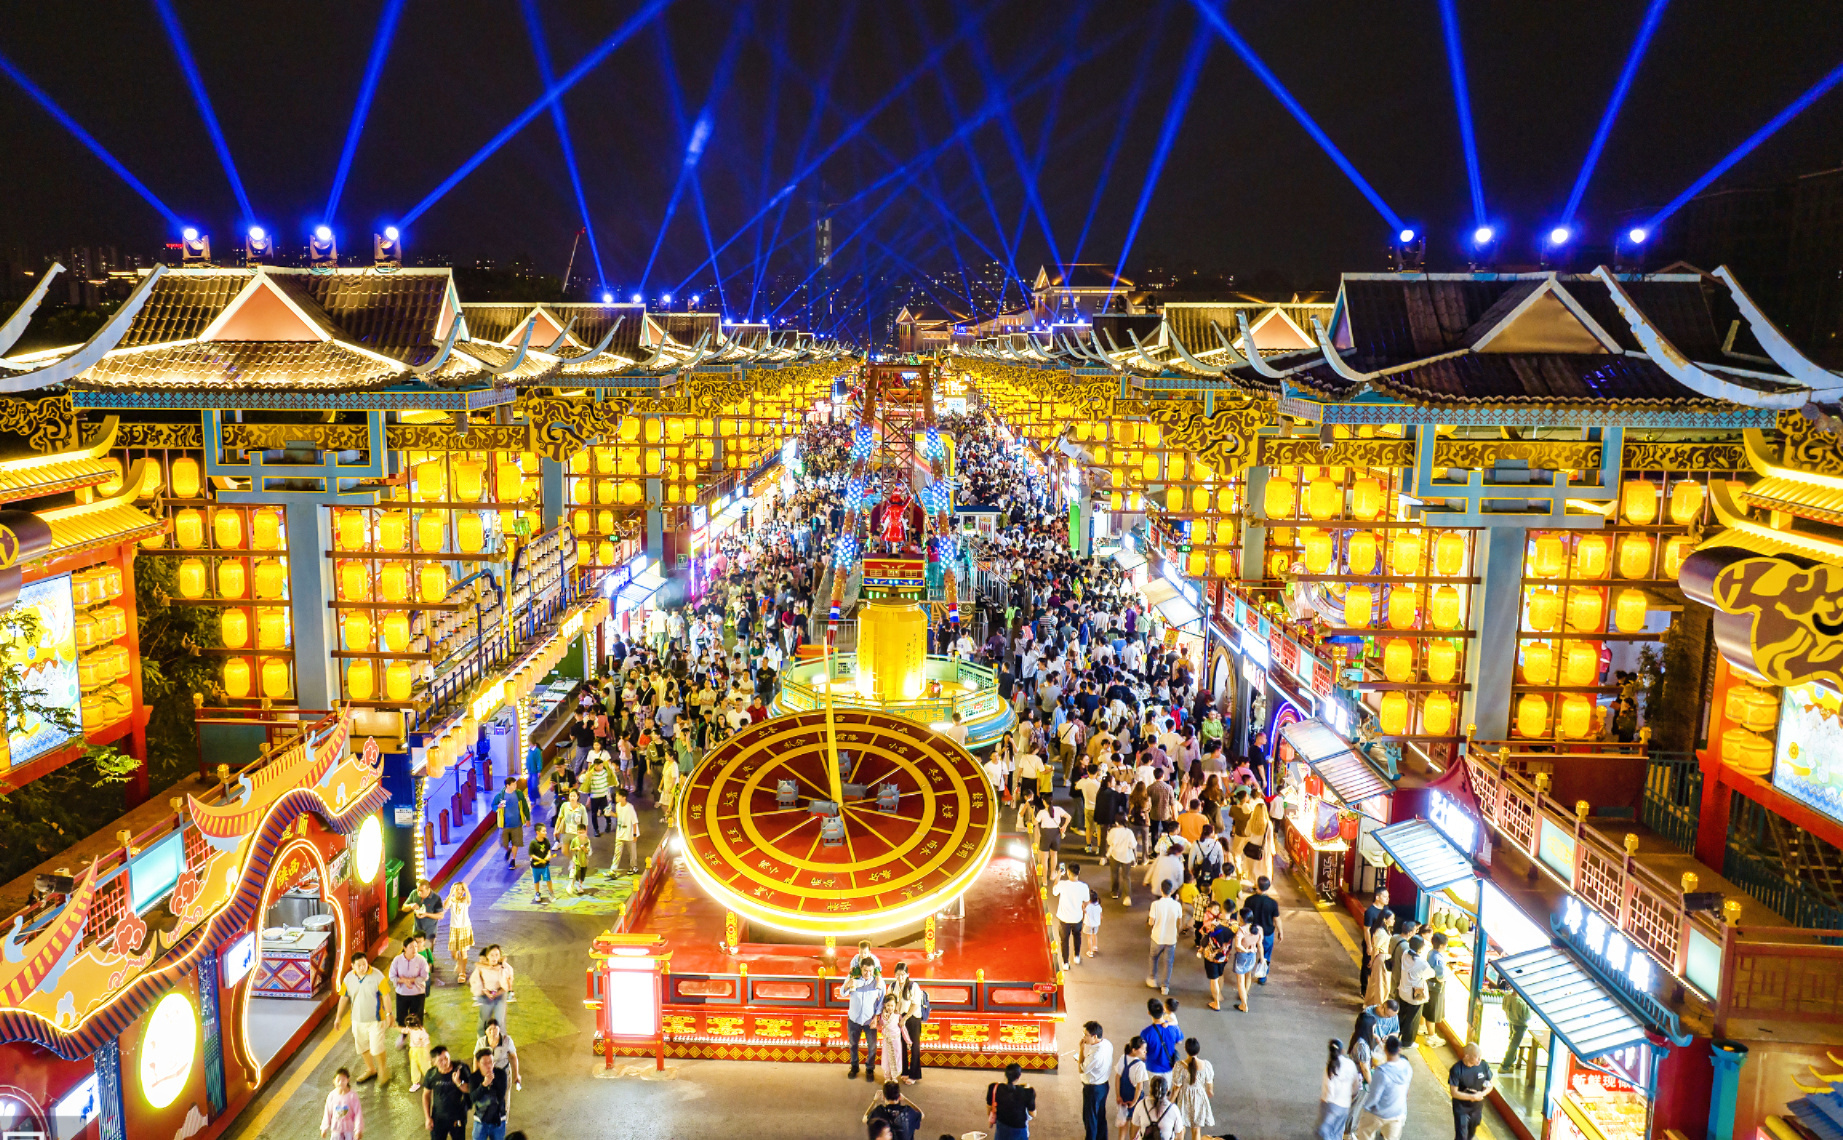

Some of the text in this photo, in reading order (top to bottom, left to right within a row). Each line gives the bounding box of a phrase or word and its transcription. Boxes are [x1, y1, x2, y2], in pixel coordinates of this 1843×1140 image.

[783, 738, 806, 749] 秋分
[691, 804, 702, 820] 白露
[727, 827, 742, 844] 夏至
[920, 840, 937, 855] 雨水
[956, 841, 975, 858] 清明
[277, 858, 300, 889] 陕西
[868, 870, 892, 881] 春分
[827, 901, 851, 911] 芒种
